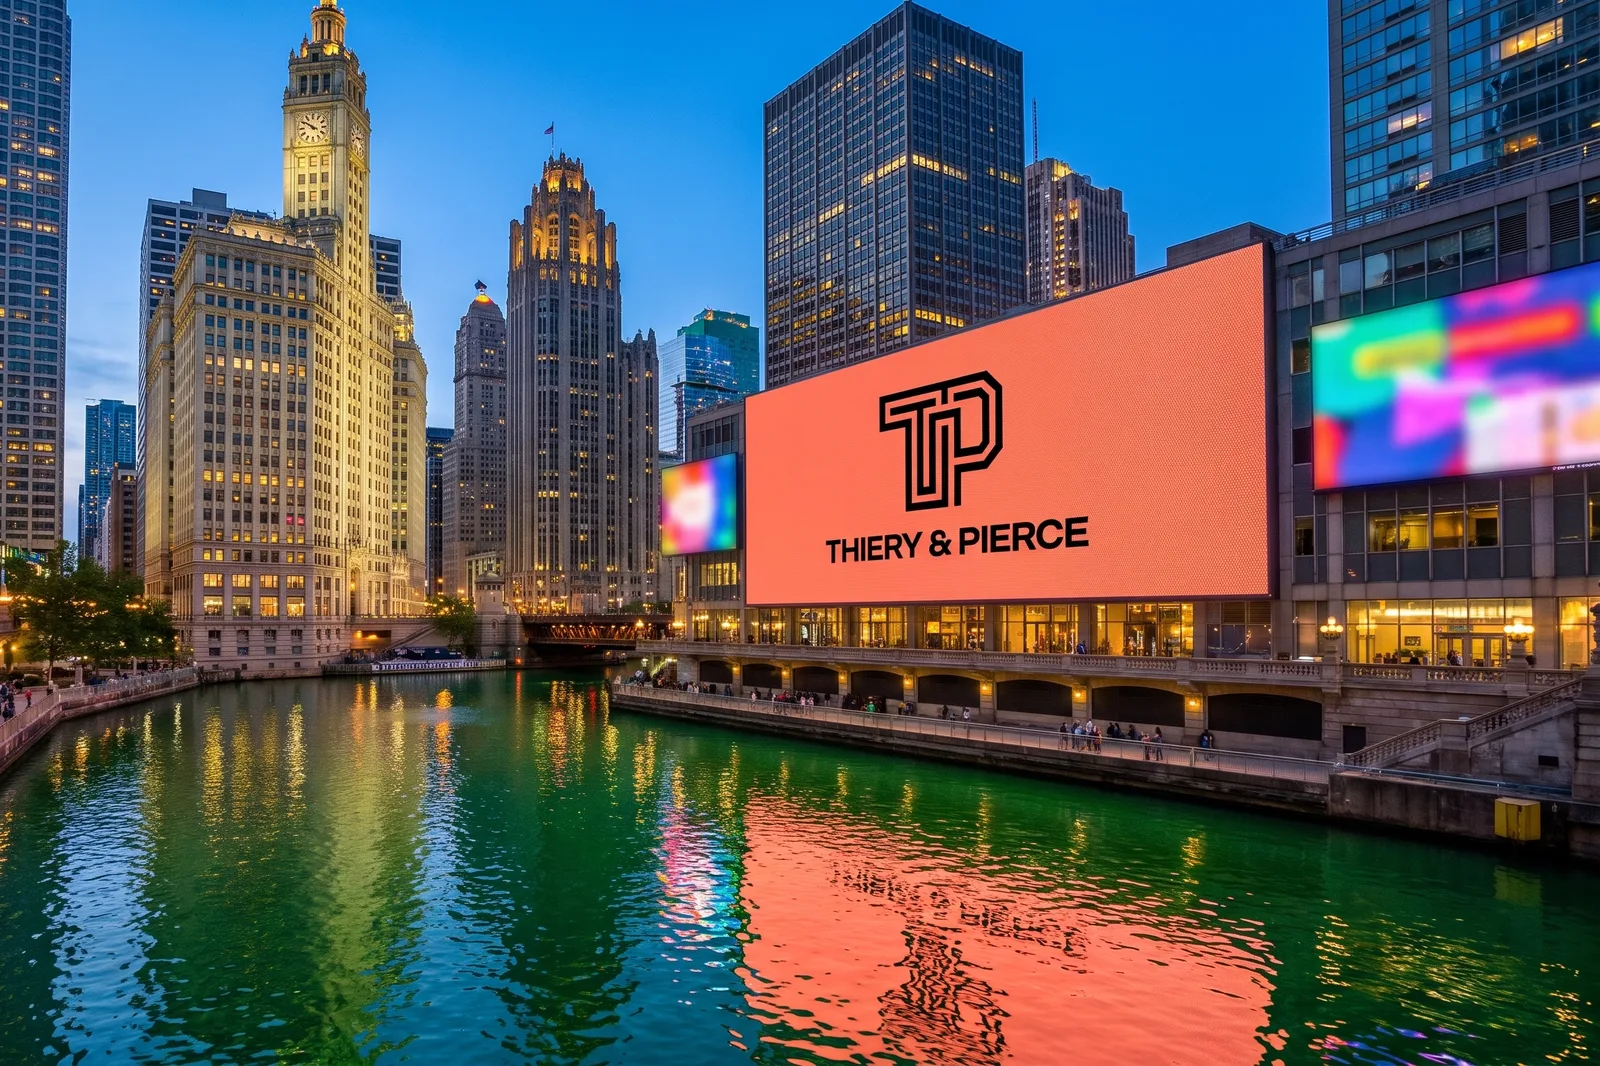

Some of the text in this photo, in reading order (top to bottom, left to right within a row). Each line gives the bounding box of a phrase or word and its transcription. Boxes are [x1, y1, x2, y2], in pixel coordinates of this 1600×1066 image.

[826, 516, 1089, 563] THIERY & PIERCE
